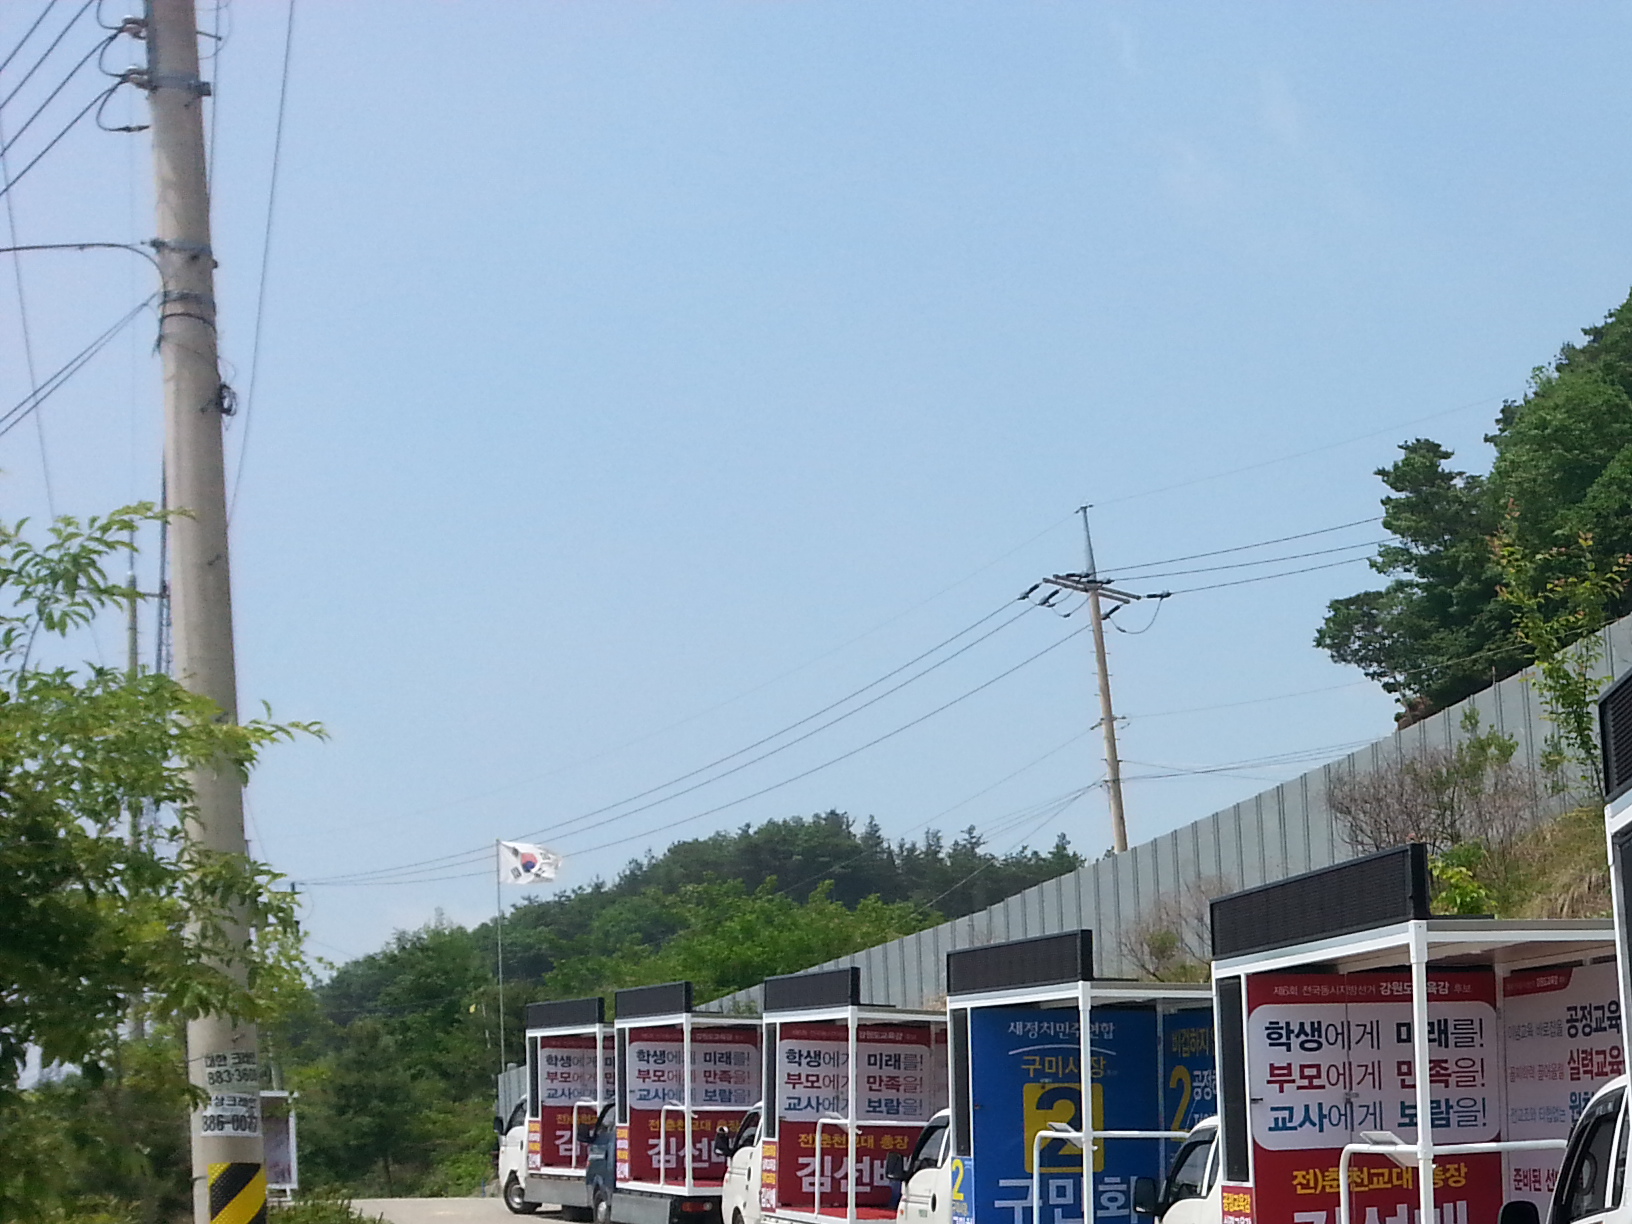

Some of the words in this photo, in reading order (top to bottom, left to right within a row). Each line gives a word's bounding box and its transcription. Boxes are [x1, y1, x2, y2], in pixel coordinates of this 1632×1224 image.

[1264, 1020, 1381, 1052] 학생에게
[866, 1052, 923, 1071] 미래를!
[1266, 1060, 1382, 1094] 부모에게
[866, 1075, 923, 1093] 만족을!
[865, 1097, 923, 1116] 보람을!
[1268, 1100, 1384, 1133] 교사에게
[952, 1158, 965, 1201] 2
